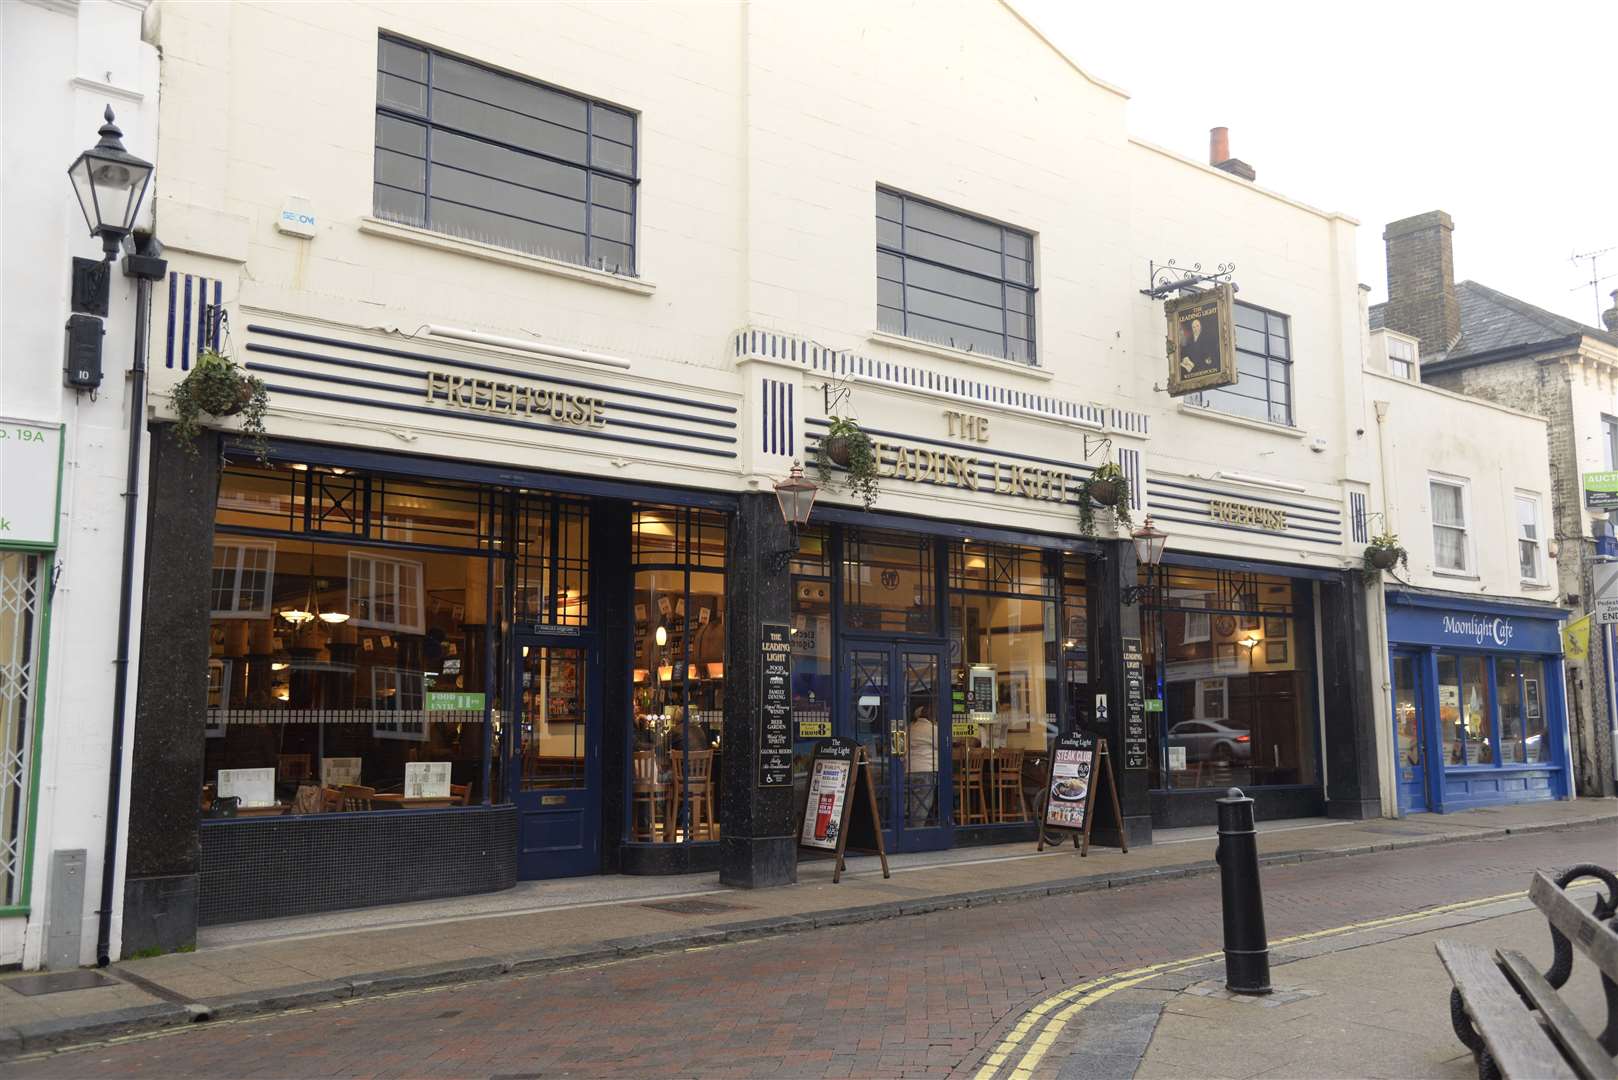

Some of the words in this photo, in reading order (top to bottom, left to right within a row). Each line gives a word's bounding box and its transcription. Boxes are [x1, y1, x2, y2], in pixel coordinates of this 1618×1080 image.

[426, 371, 607, 429] FREEHOUSE
[944, 410, 990, 442] THE
[16, 429, 45, 443] 19A
[874, 442, 980, 491] EADING
[993, 462, 1072, 503] LIGHT
[1208, 499, 1289, 531] FREEHOUSE
[1443, 614, 1493, 645] Moonlight
[770, 633, 782, 641] THE
[762, 642, 791, 652] LEADING
[767, 653, 786, 662] LIGHT
[832, 739, 841, 747] The
[1061, 739, 1080, 747] Leading
[1080, 739, 1092, 748] Light
[820, 746, 838, 756] Leading
[838, 747, 850, 757] Light
[1056, 750, 1076, 761] STEAK
